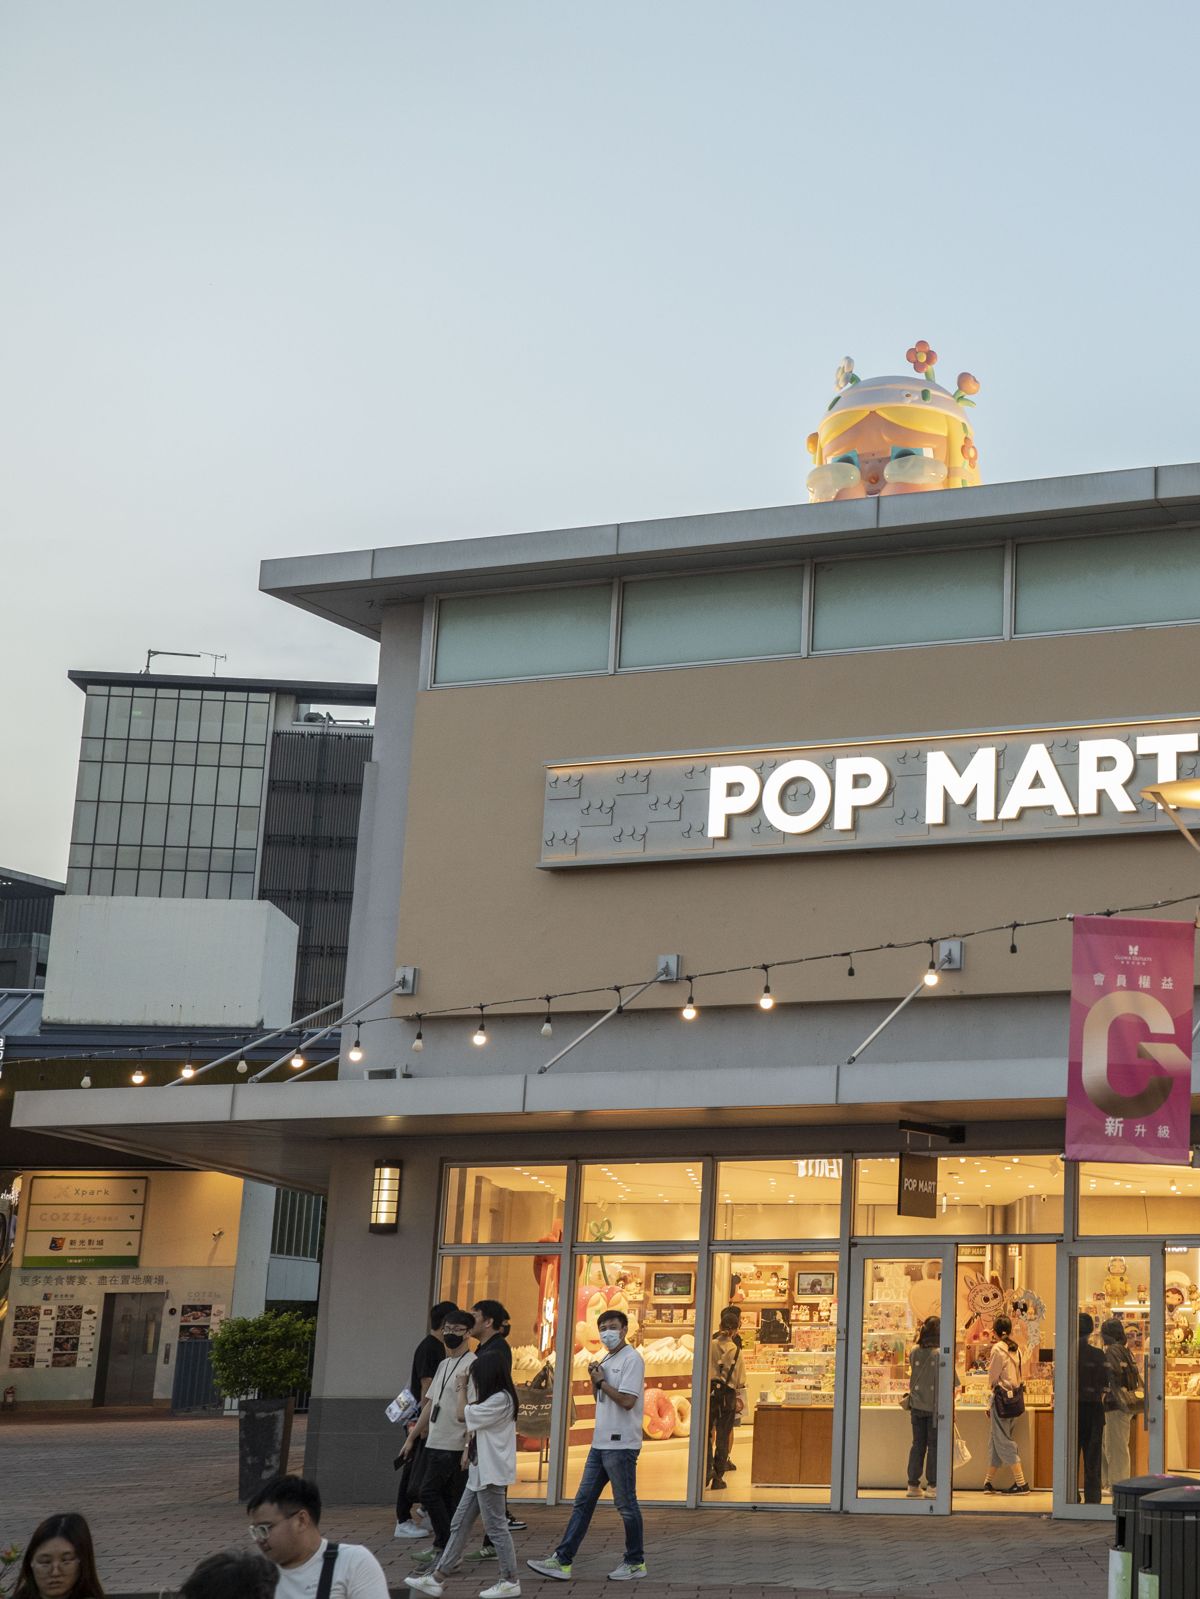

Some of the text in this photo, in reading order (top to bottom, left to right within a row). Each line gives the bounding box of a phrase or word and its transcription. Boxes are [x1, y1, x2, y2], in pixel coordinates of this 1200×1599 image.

[708, 733, 1199, 838] POP MART
[1093, 972, 1174, 990] 會員權益
[1105, 1117, 1170, 1138] 新升級
[74, 1187, 111, 1198] Xpark
[904, 1178, 937, 1194] POP MART
[960, 1247, 972, 1255] POP
